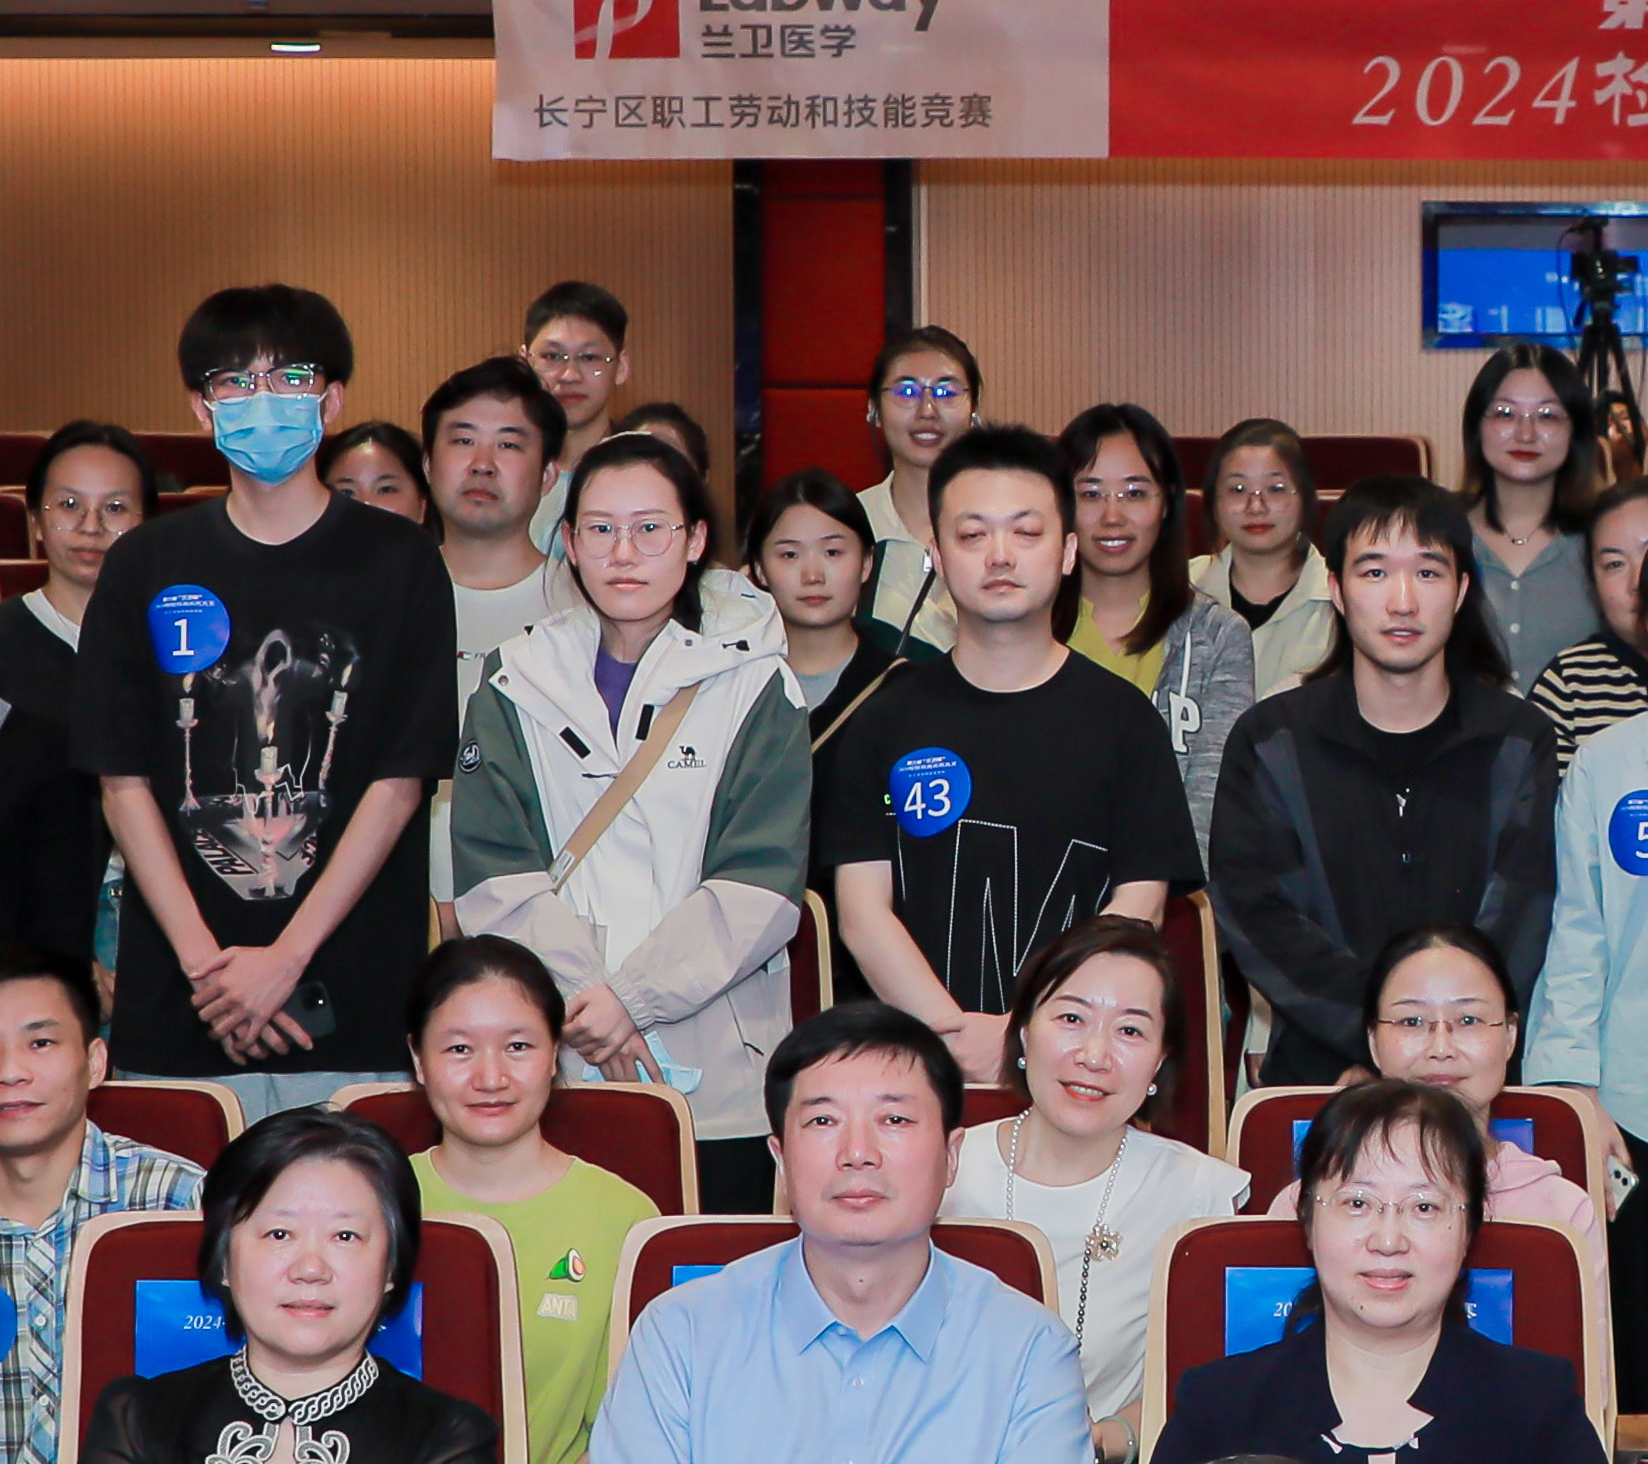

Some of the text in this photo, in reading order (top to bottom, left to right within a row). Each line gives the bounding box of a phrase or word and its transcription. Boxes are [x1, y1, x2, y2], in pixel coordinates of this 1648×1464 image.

[701, 24, 858, 59] 兰卫医学
[534, 93, 993, 129] 长宁区职工劳动和技能竞赛
[172, 618, 195, 656] 1
[667, 760, 707, 770] CAMEL
[903, 778, 951, 819] 43
[540, 1294, 576, 1317] ANTA
